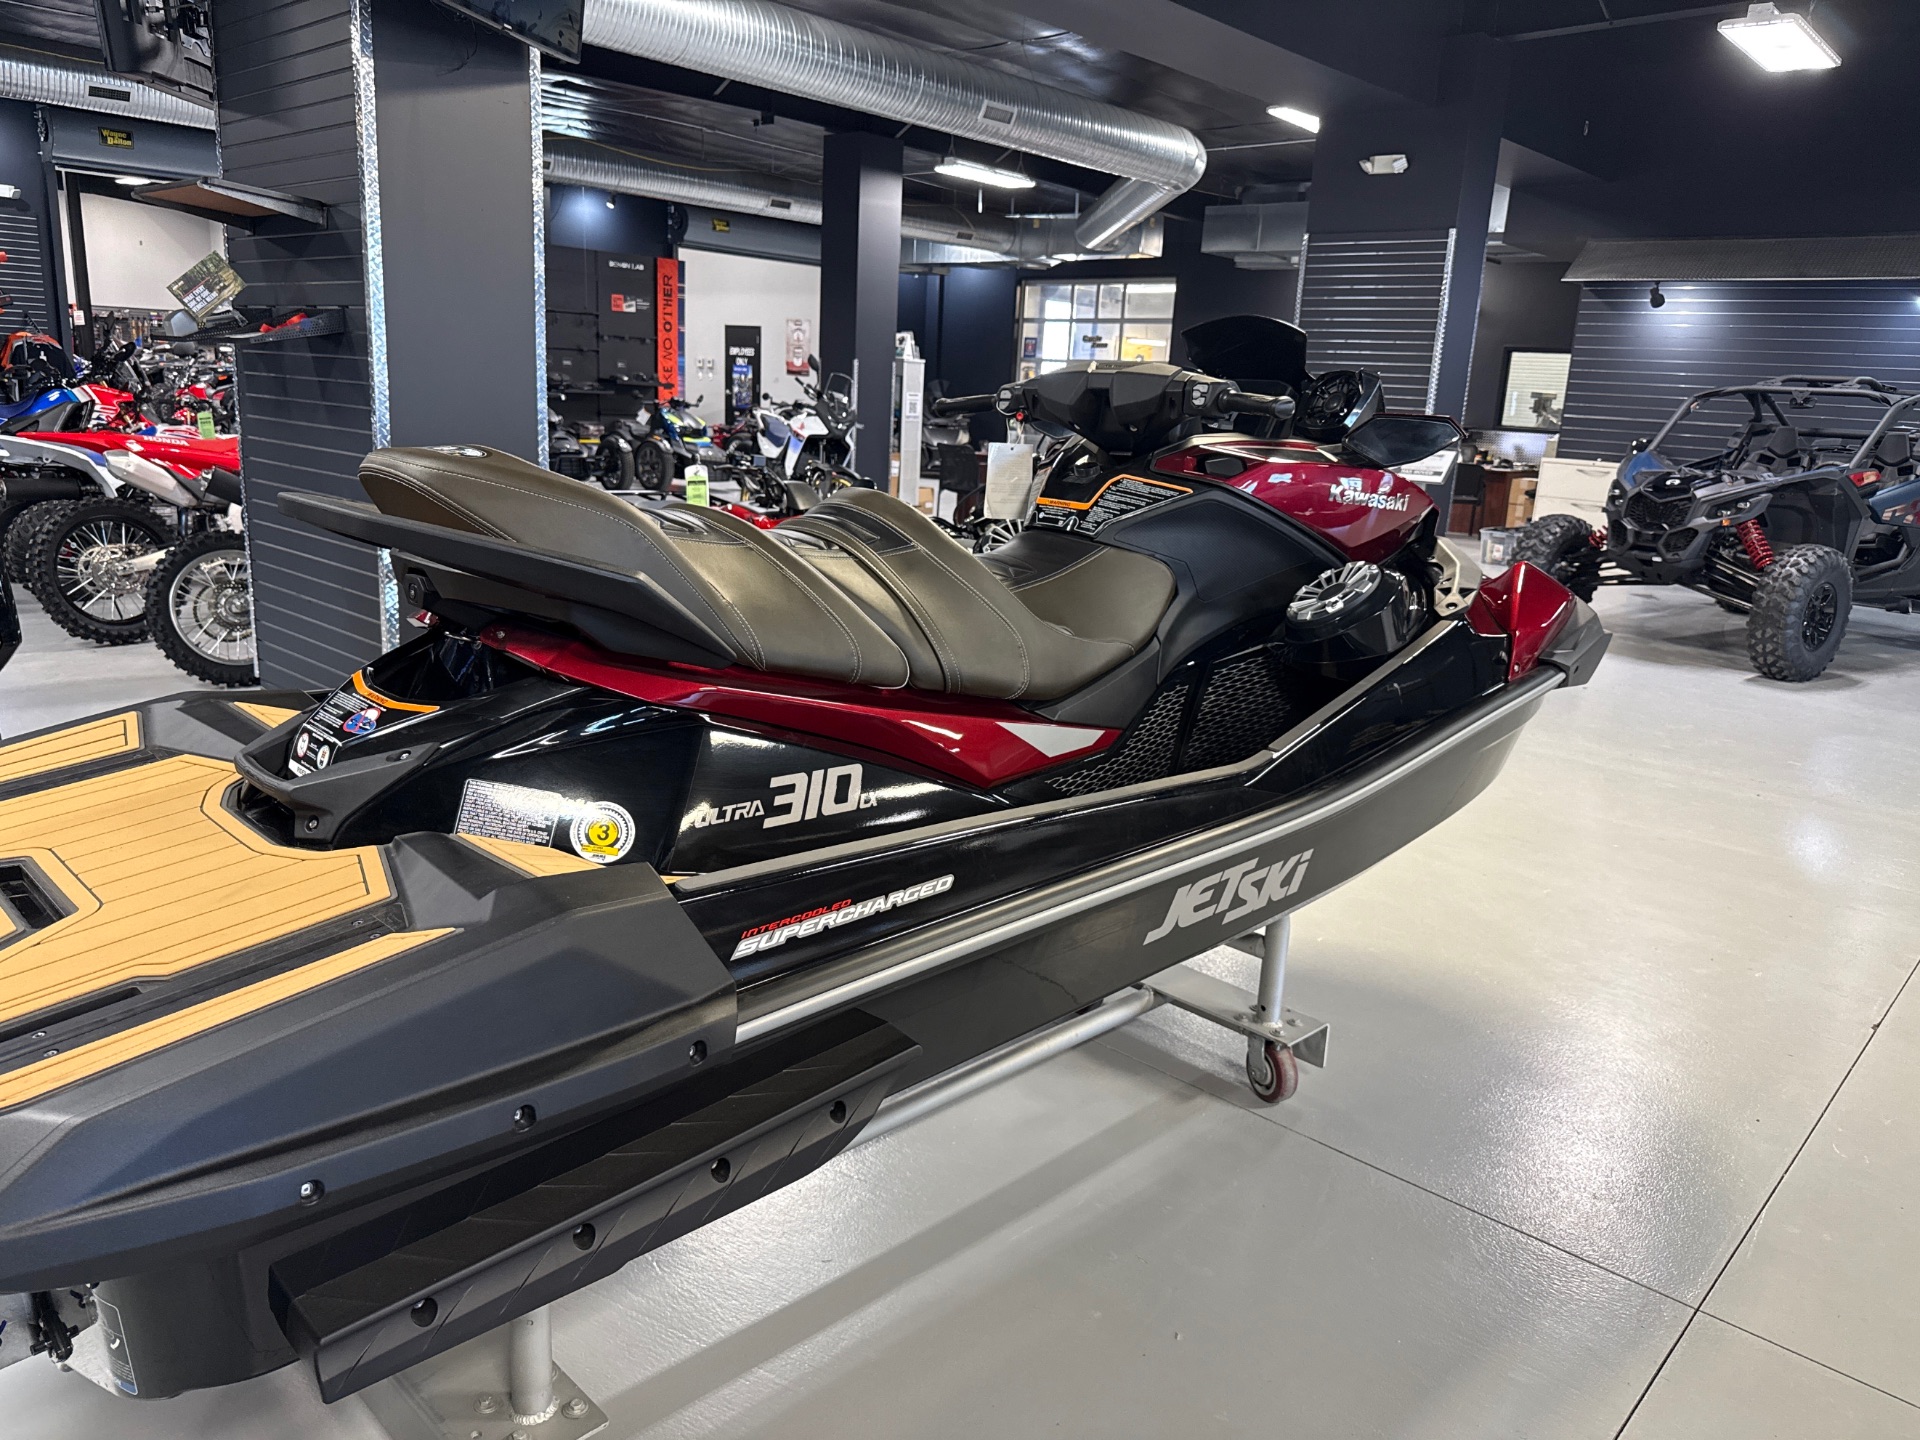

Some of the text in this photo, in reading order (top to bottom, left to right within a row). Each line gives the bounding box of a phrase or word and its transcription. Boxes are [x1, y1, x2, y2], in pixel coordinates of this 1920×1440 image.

[101, 129, 127, 139] Wayne
[107, 136, 131, 146] Dalton
[662, 274, 673, 333] OTHER
[663, 337, 673, 361] NO
[729, 346, 755, 357] EMPLOYEES
[736, 357, 748, 365] ONLY
[143, 435, 190, 446] HONDA
[1328, 483, 1411, 512] Kawasaki
[693, 799, 765, 829] ULTRA
[763, 763, 863, 829] 310
[597, 824, 610, 841] 3
[730, 873, 955, 961] SUPERCHARGED
[740, 898, 852, 939] INTERCOOLED
